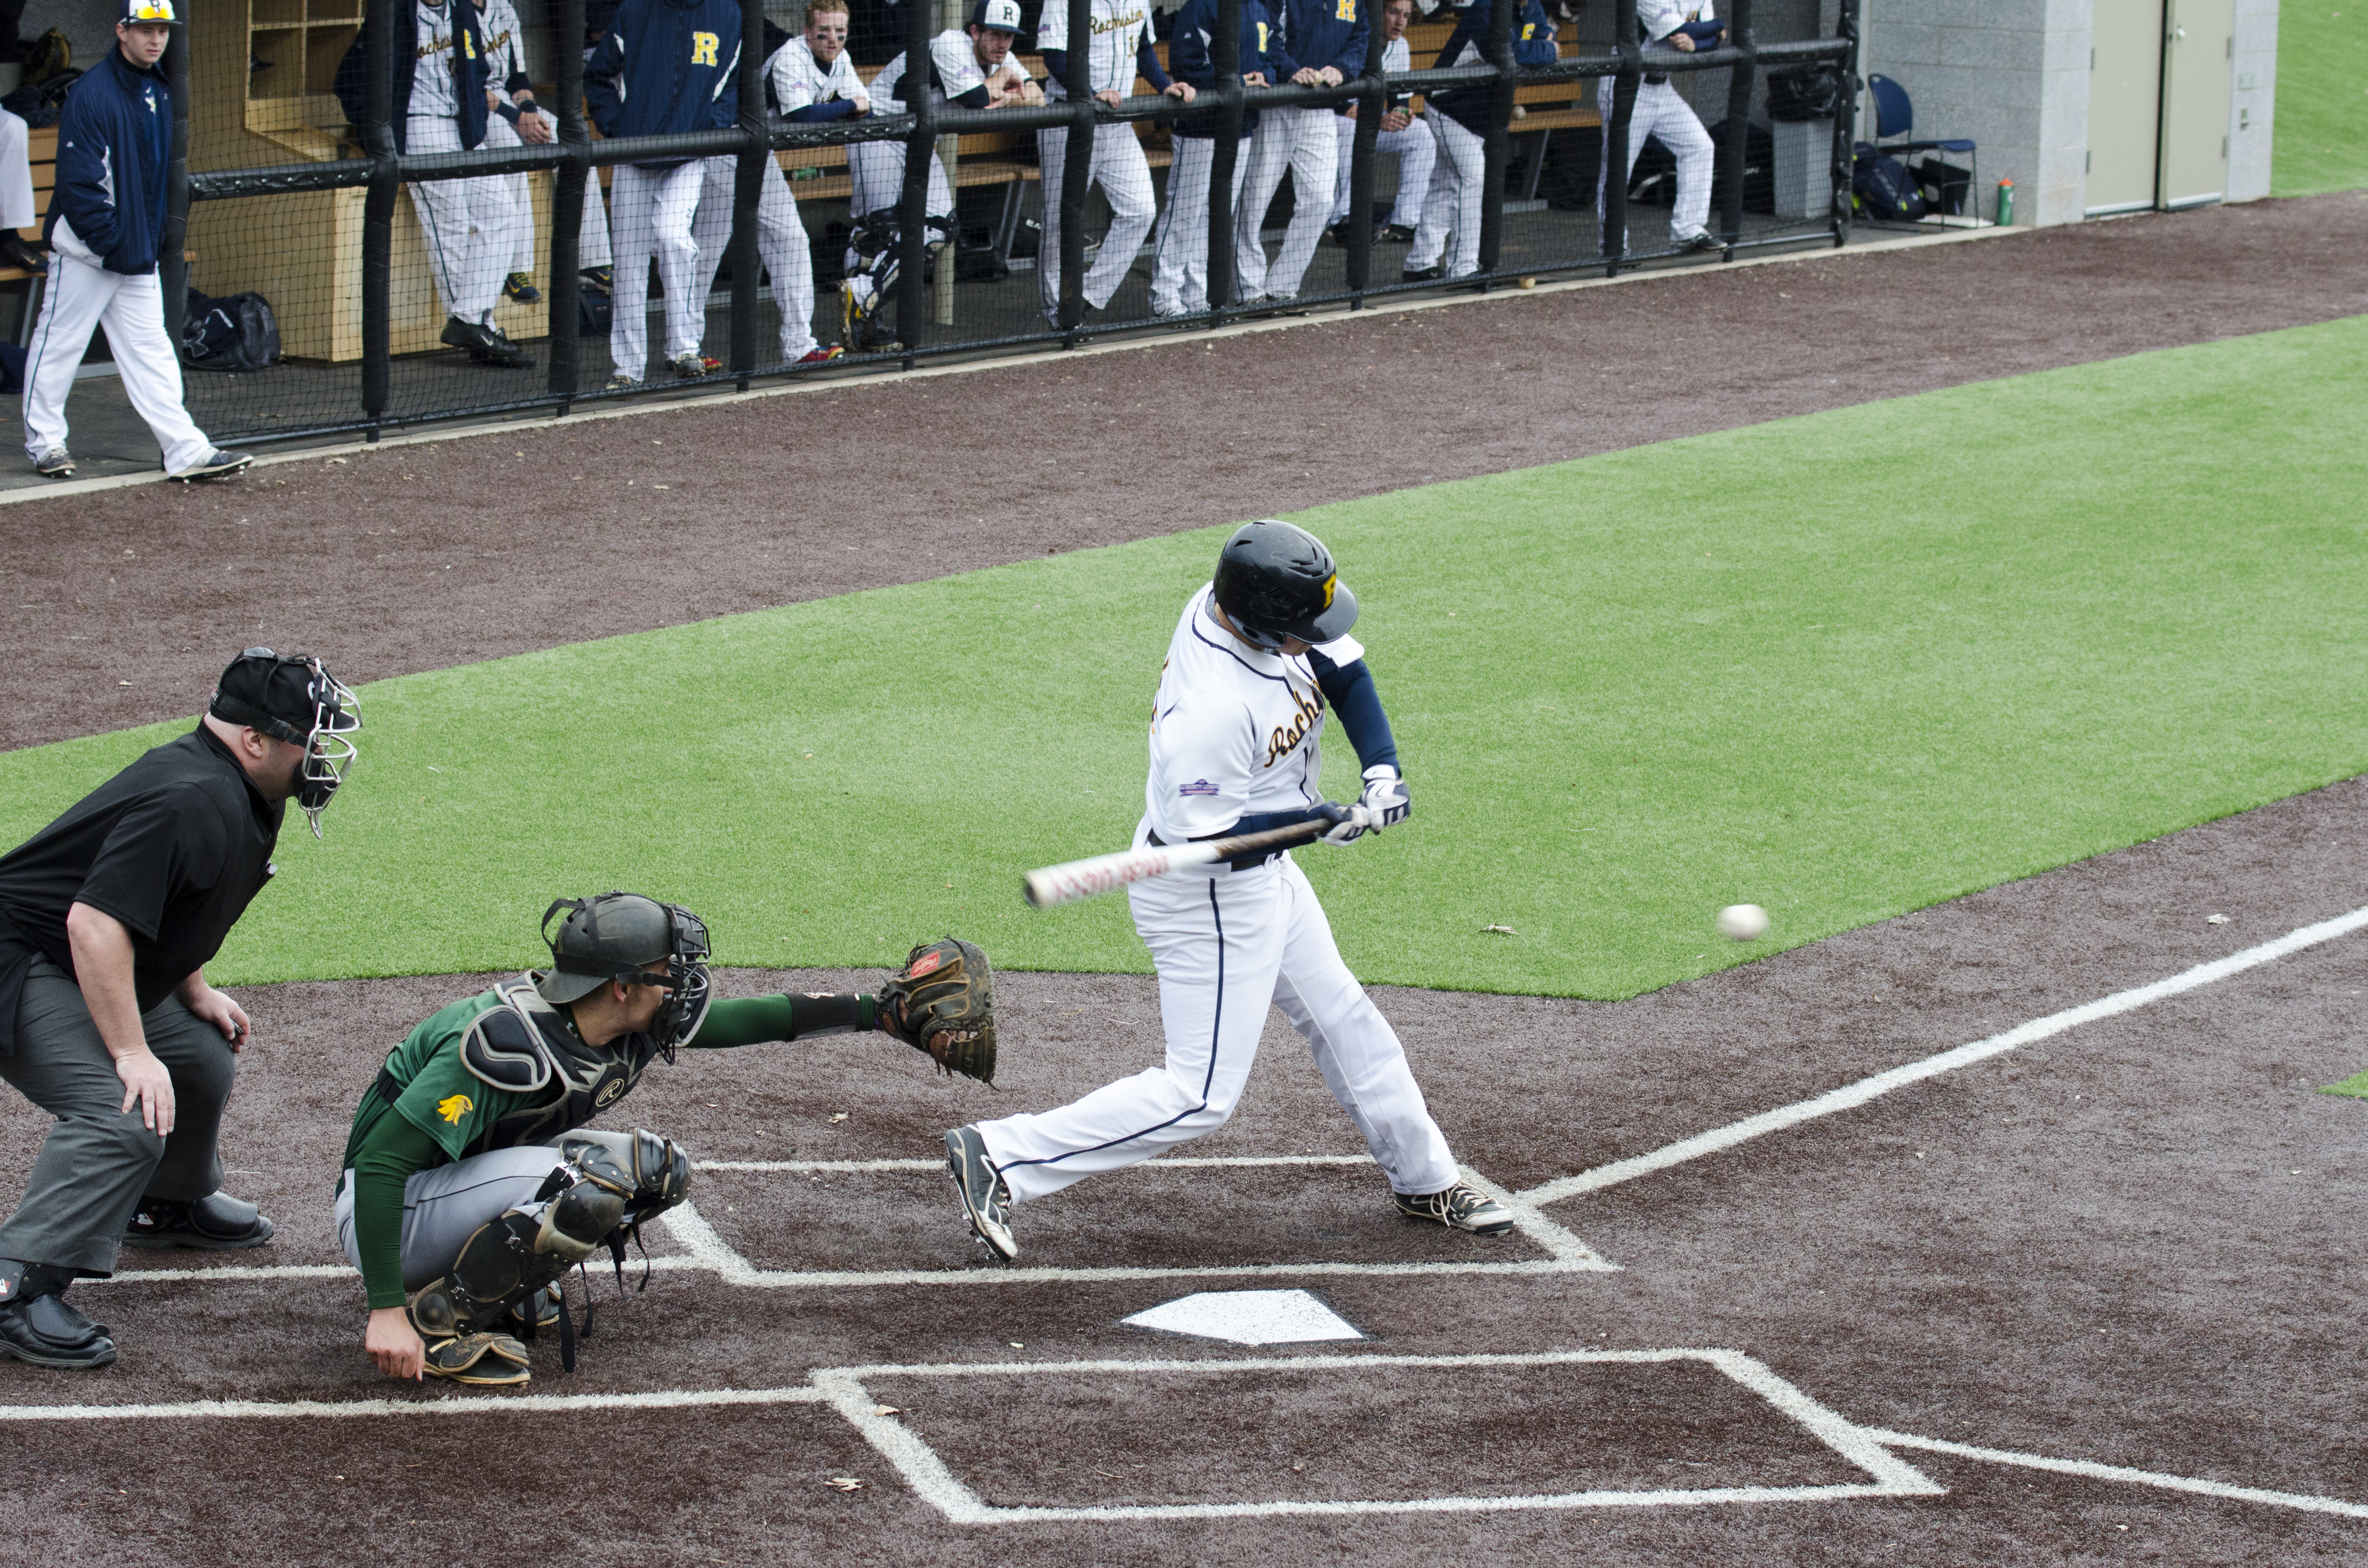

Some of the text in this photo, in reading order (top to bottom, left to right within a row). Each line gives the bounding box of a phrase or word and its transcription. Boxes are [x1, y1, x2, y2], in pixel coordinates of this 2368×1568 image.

[1003, 6, 1013, 21] R
[1336, 0, 1357, 23] R
[691, 31, 720, 67] R
